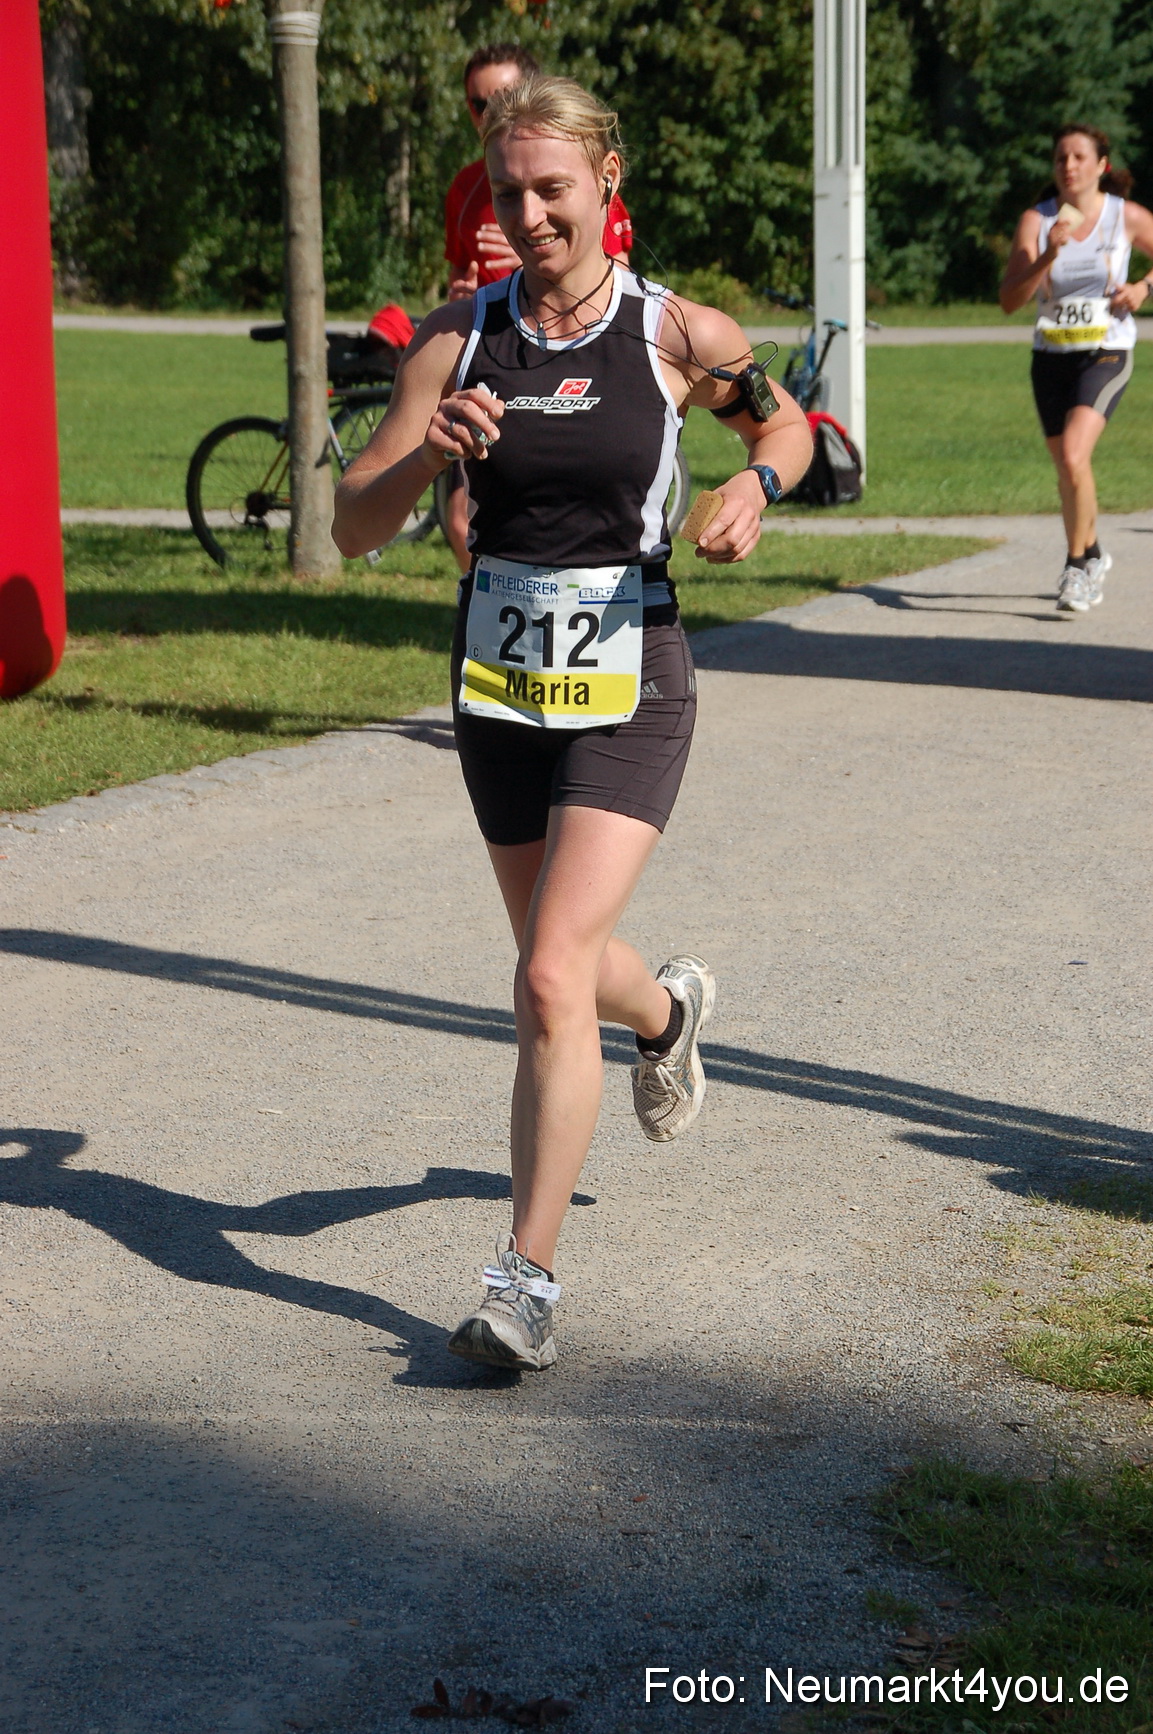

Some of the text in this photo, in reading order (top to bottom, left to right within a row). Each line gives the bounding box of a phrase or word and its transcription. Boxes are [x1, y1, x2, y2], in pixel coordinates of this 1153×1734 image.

[506, 397, 600, 410] JOLSPORT
[491, 573, 560, 596] PFLEIDERER
[579, 586, 626, 598] BOCK
[491, 589, 559, 605] AKTIENGESELLSCHAFT
[499, 605, 600, 668] 212
[504, 669, 590, 706] Maria
